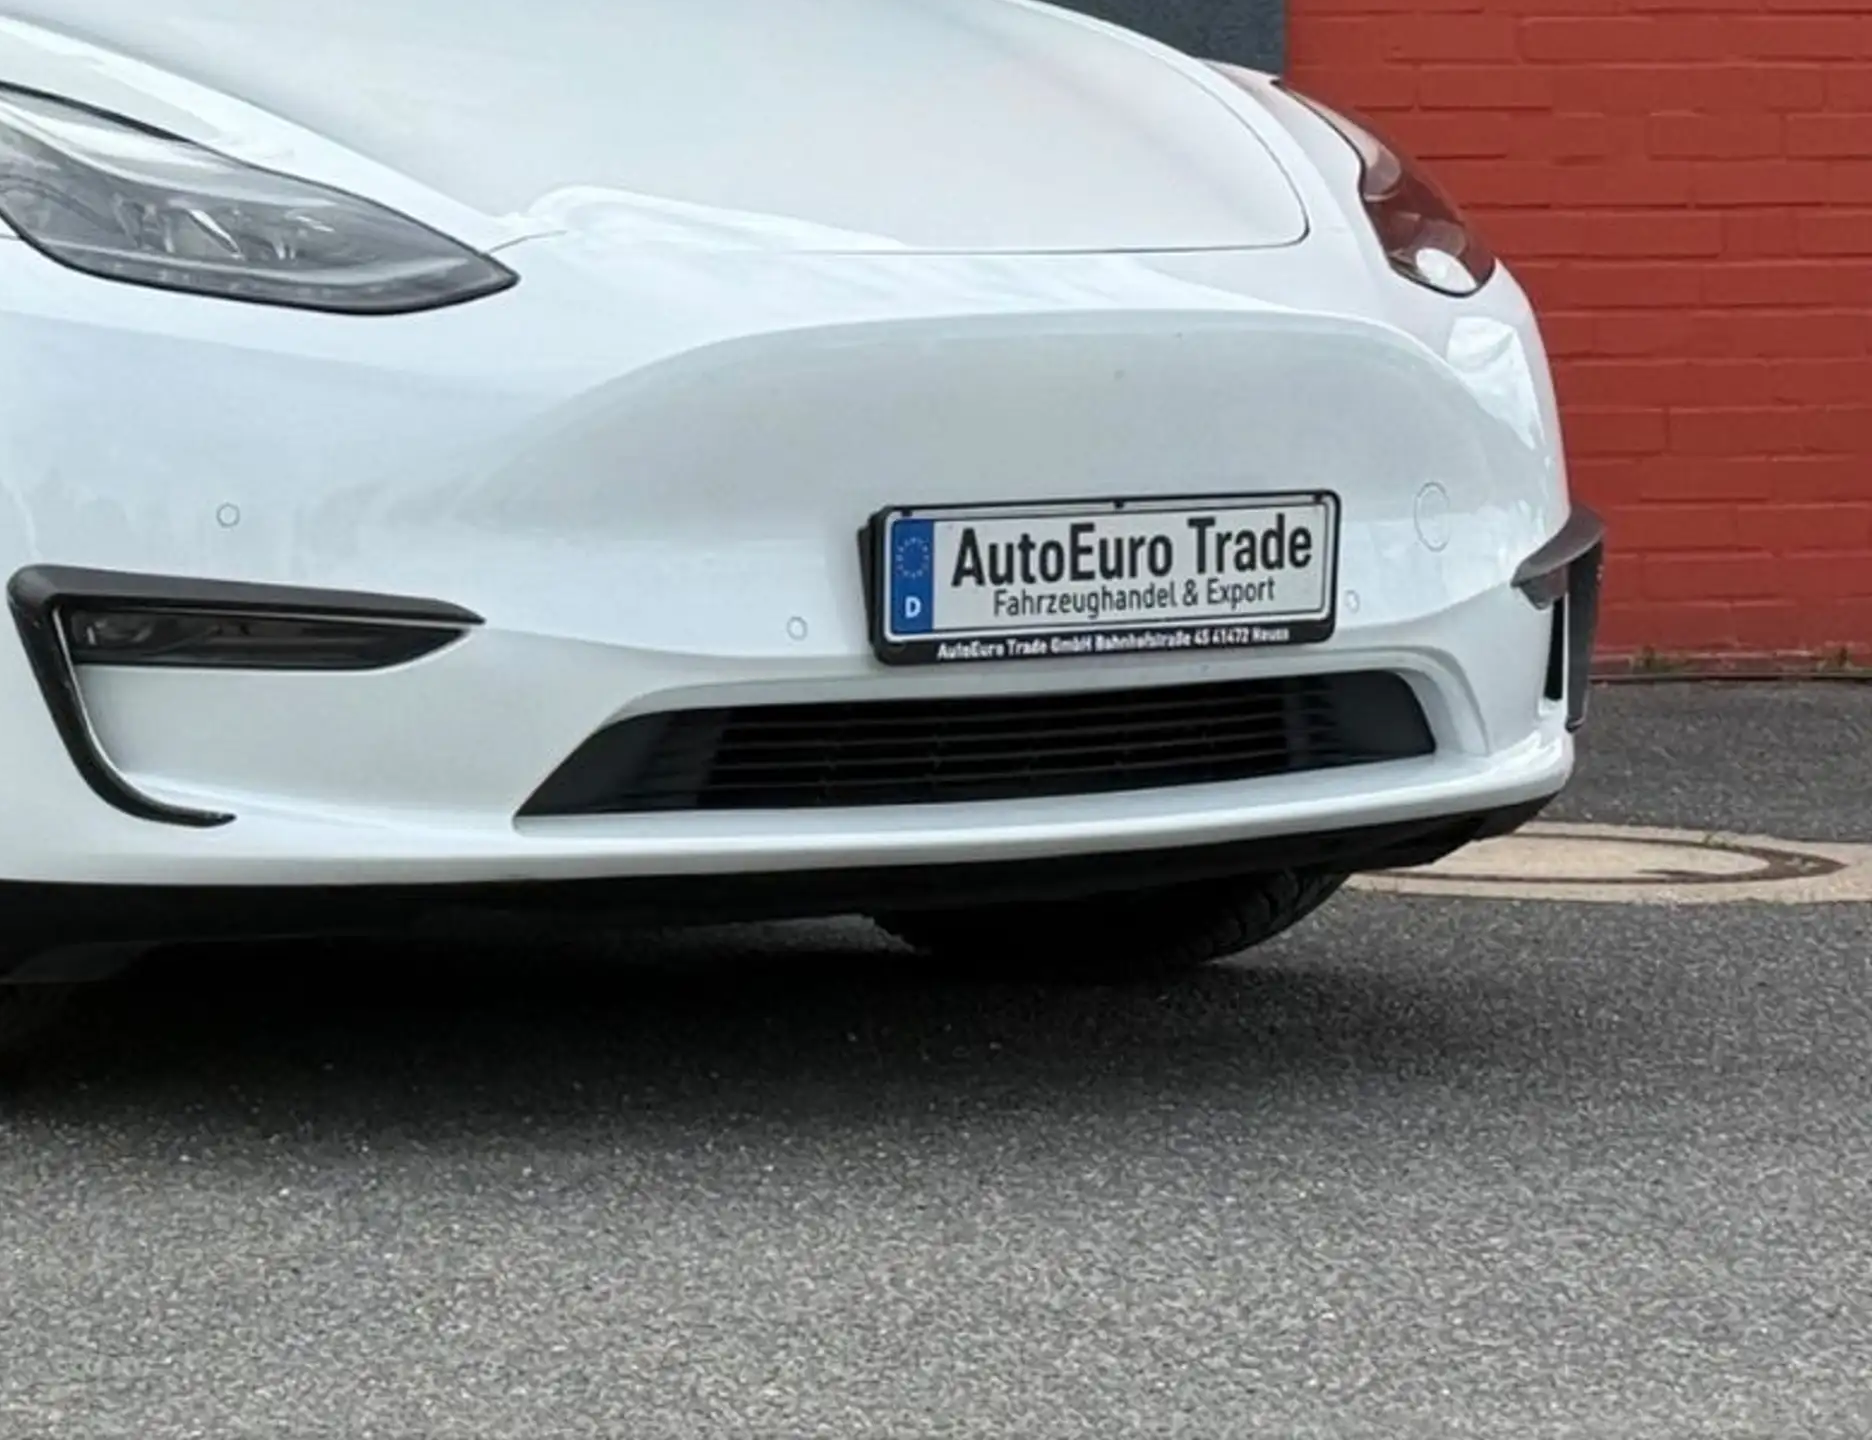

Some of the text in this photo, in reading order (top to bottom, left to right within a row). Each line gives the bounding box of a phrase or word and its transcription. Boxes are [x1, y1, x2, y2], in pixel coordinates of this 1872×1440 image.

[950, 513, 1313, 587] AutoEuro Trade
[904, 595, 922, 619] D
[993, 576, 1275, 620] Fahrzeughandel & Export
[937, 640, 1005, 659] AutoEuro
[1006, 637, 1048, 656] Trade
[1050, 635, 1093, 654] GmbH
